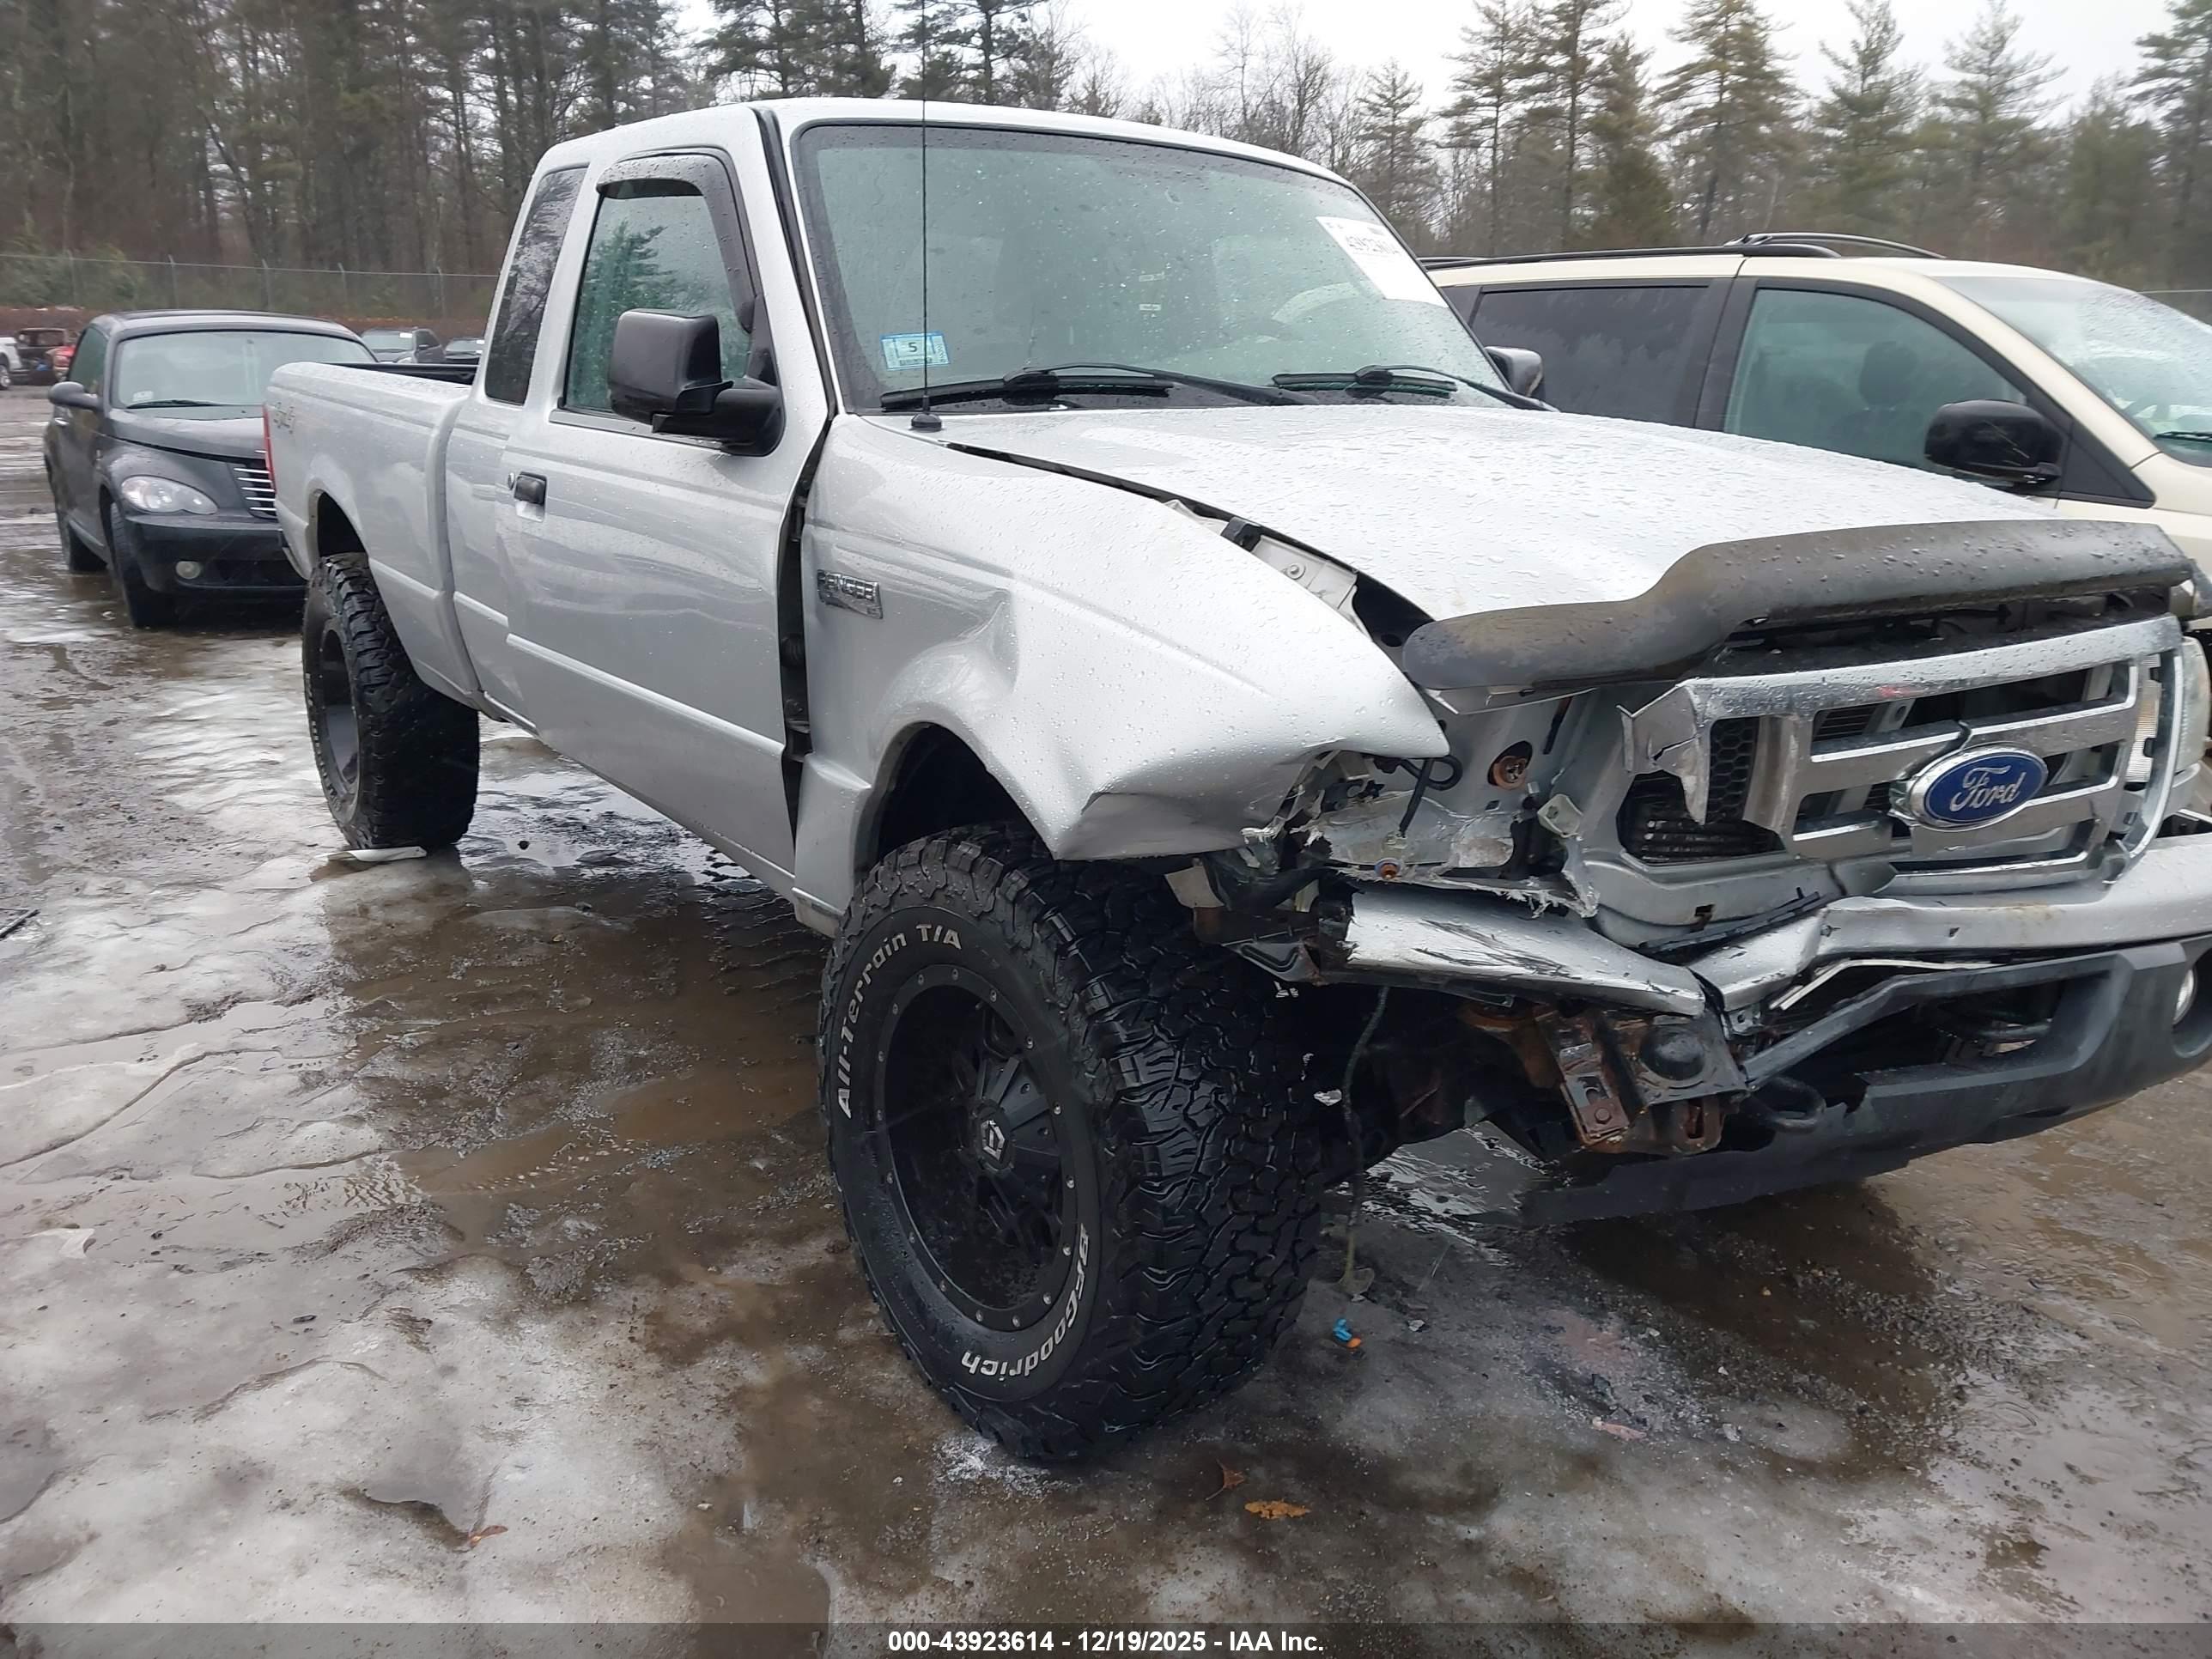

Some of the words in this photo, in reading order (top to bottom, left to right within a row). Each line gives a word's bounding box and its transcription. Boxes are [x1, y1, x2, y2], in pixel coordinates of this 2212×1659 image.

[1949, 764, 2027, 812] Ford
[838, 932, 907, 1119] All-Terrain
[915, 922, 963, 951] T/A
[961, 1222, 1089, 1382] BFGoodrich
